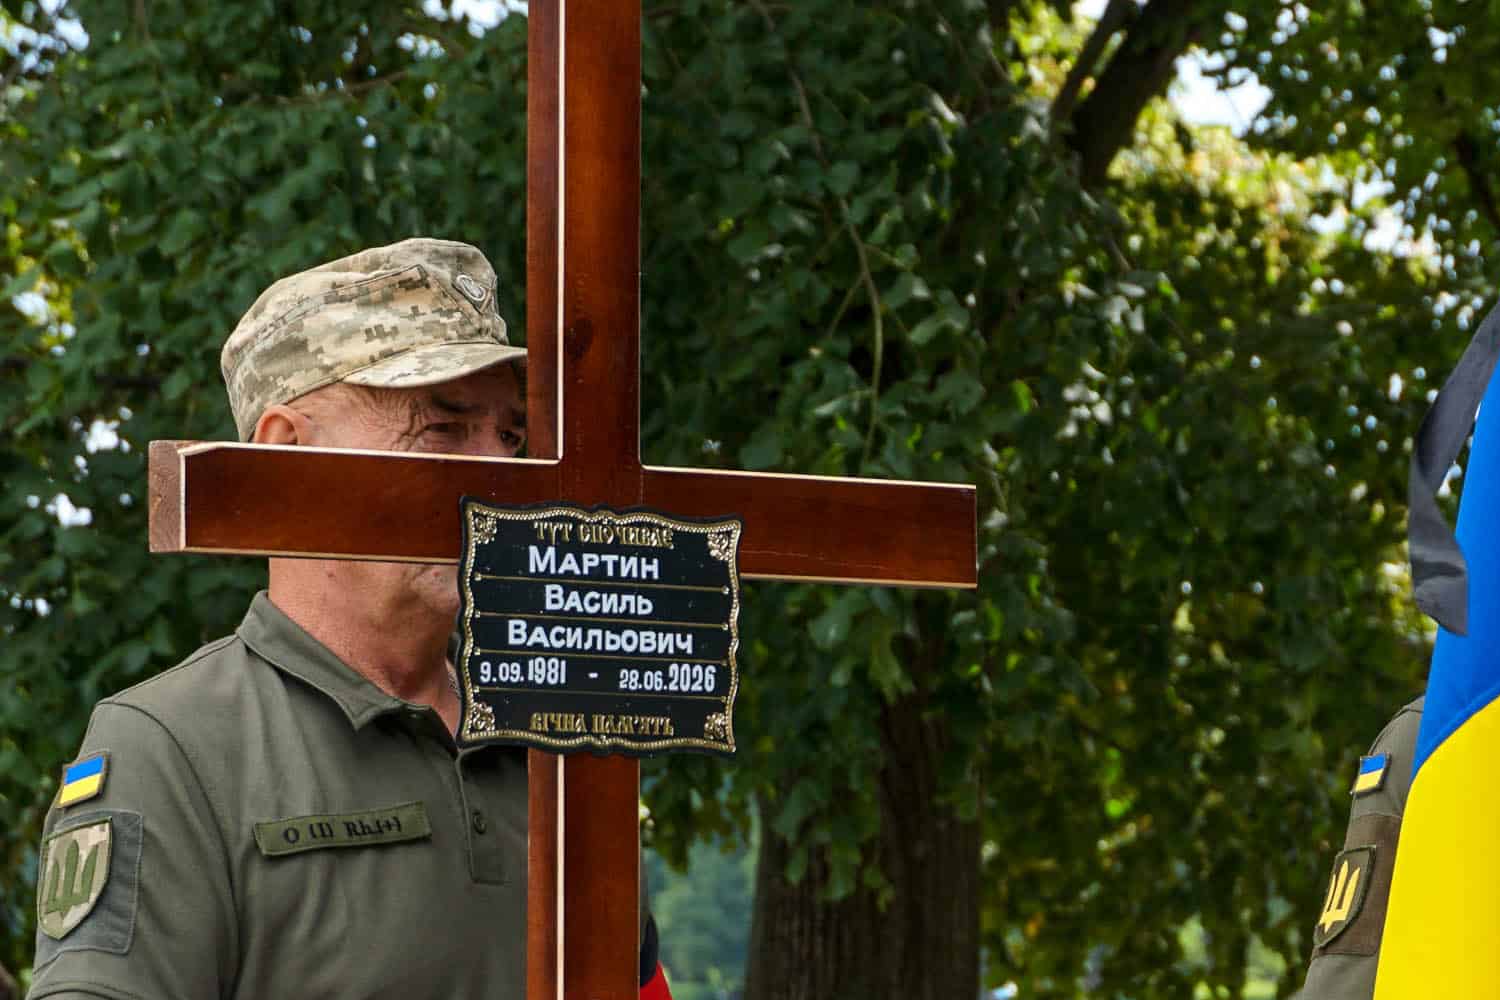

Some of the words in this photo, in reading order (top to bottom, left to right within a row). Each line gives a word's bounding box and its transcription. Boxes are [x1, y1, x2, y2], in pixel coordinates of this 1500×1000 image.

[533, 521, 573, 544] ТУТ
[480, 657, 565, 684] 9.09.1981
[620, 664, 716, 691] 28.06.2026
